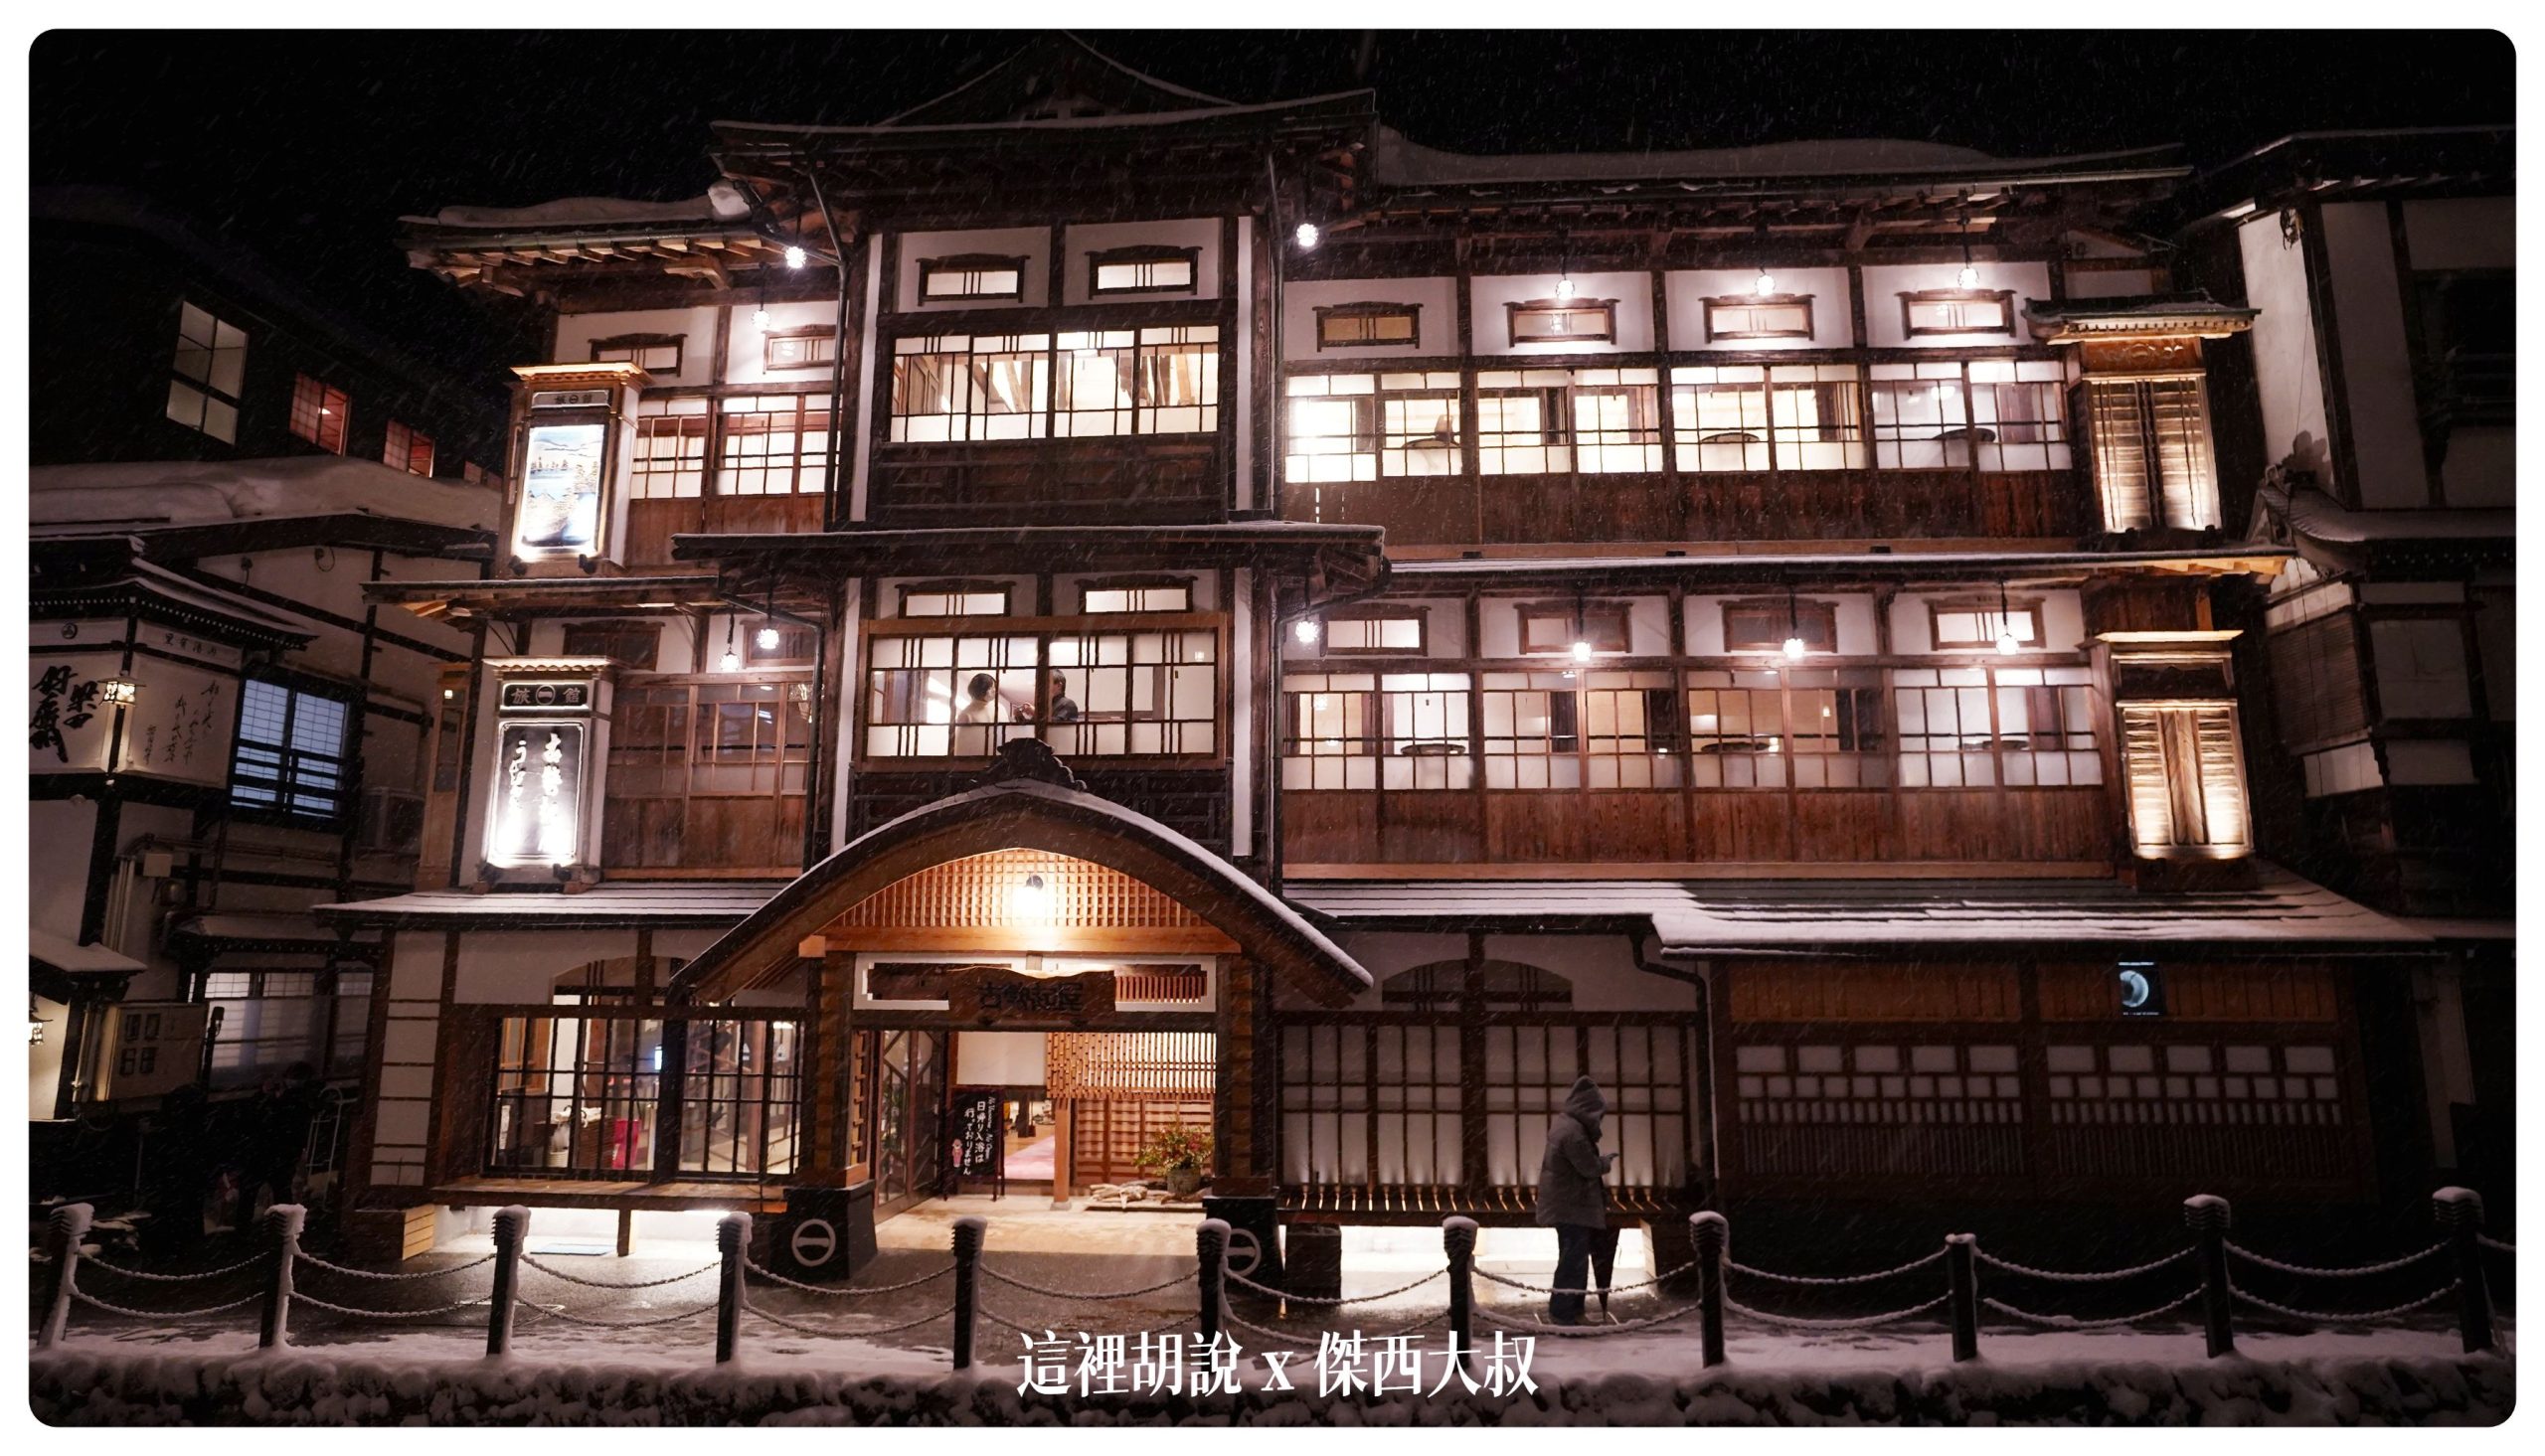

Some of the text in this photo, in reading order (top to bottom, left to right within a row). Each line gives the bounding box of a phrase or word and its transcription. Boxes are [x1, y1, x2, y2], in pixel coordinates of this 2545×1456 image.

[962, 1107, 975, 1176] 行っておりません
[974, 1100, 987, 1164] 日帰り入浴は
